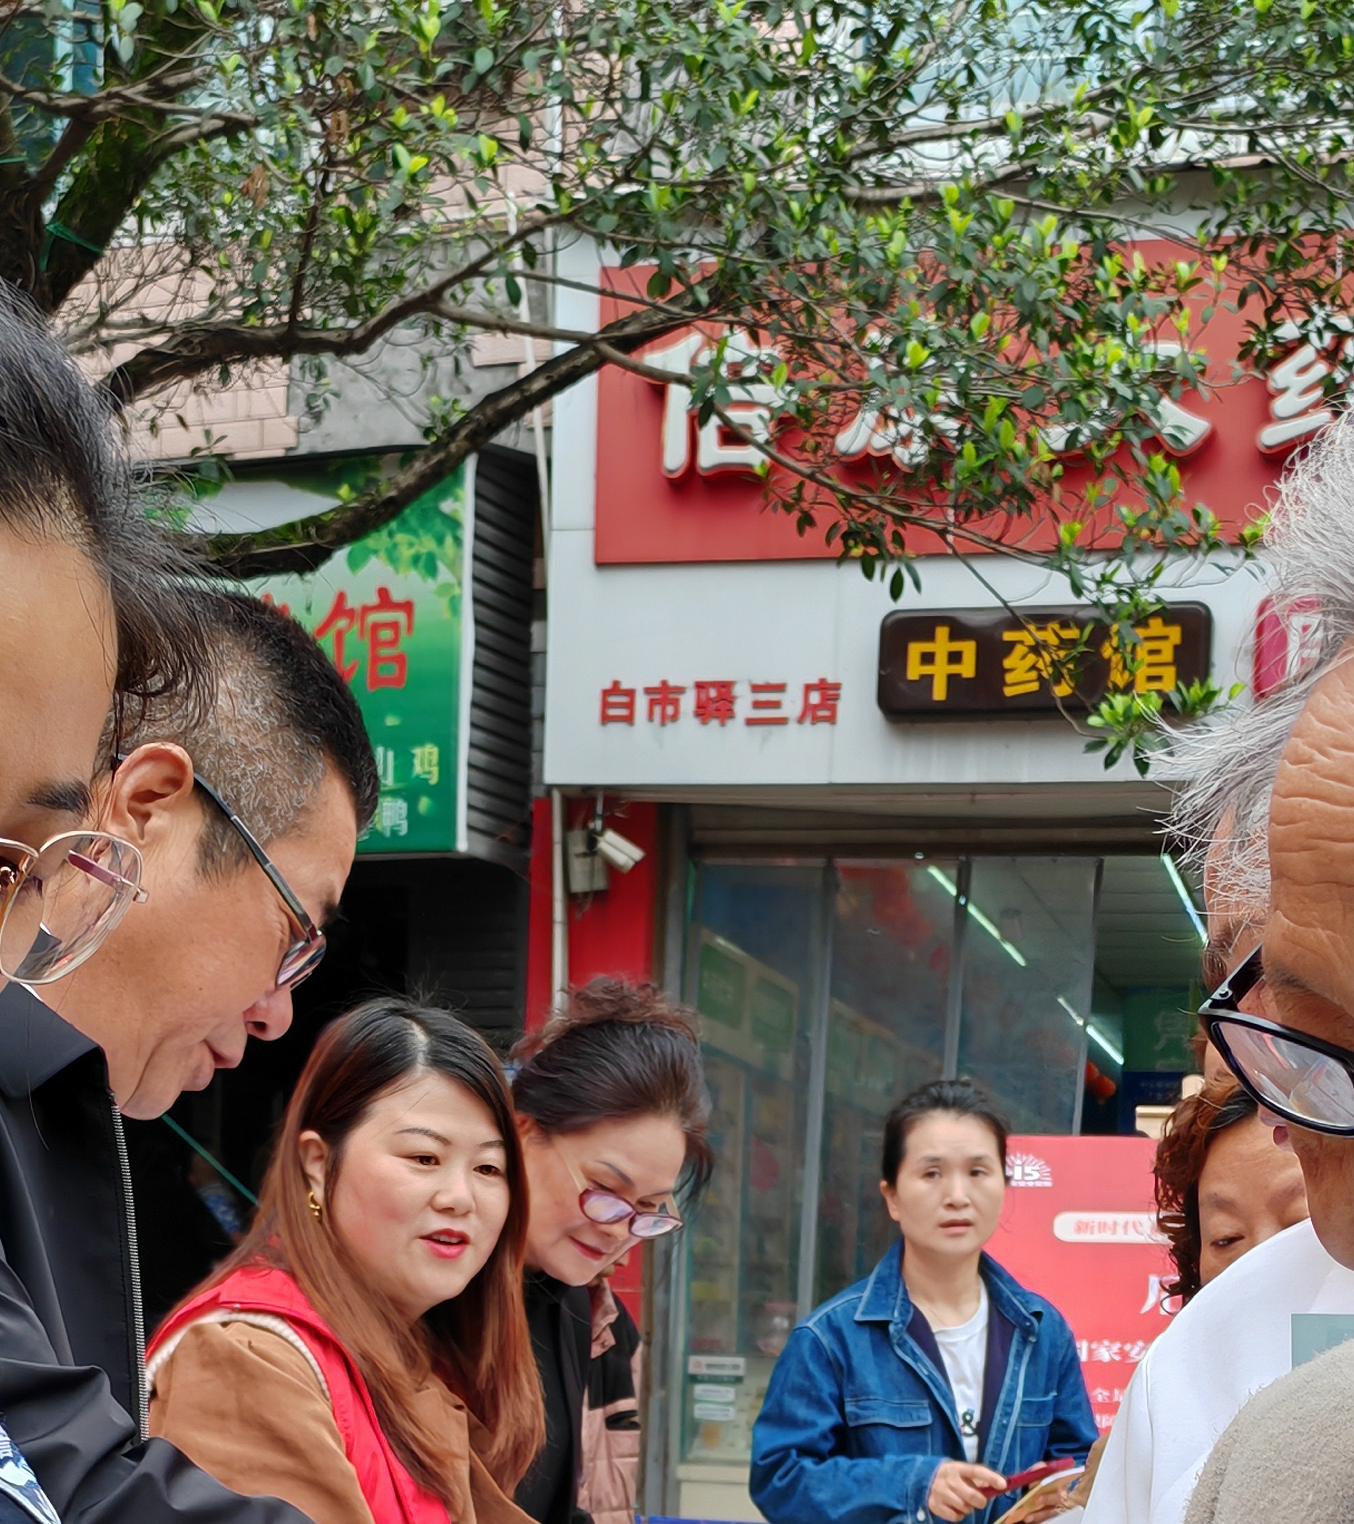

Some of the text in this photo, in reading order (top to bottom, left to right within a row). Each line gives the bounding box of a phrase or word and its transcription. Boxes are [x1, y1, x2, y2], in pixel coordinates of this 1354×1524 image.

[905, 617, 1183, 702] 中药馆
[600, 679, 842, 727] 白市驿三店
